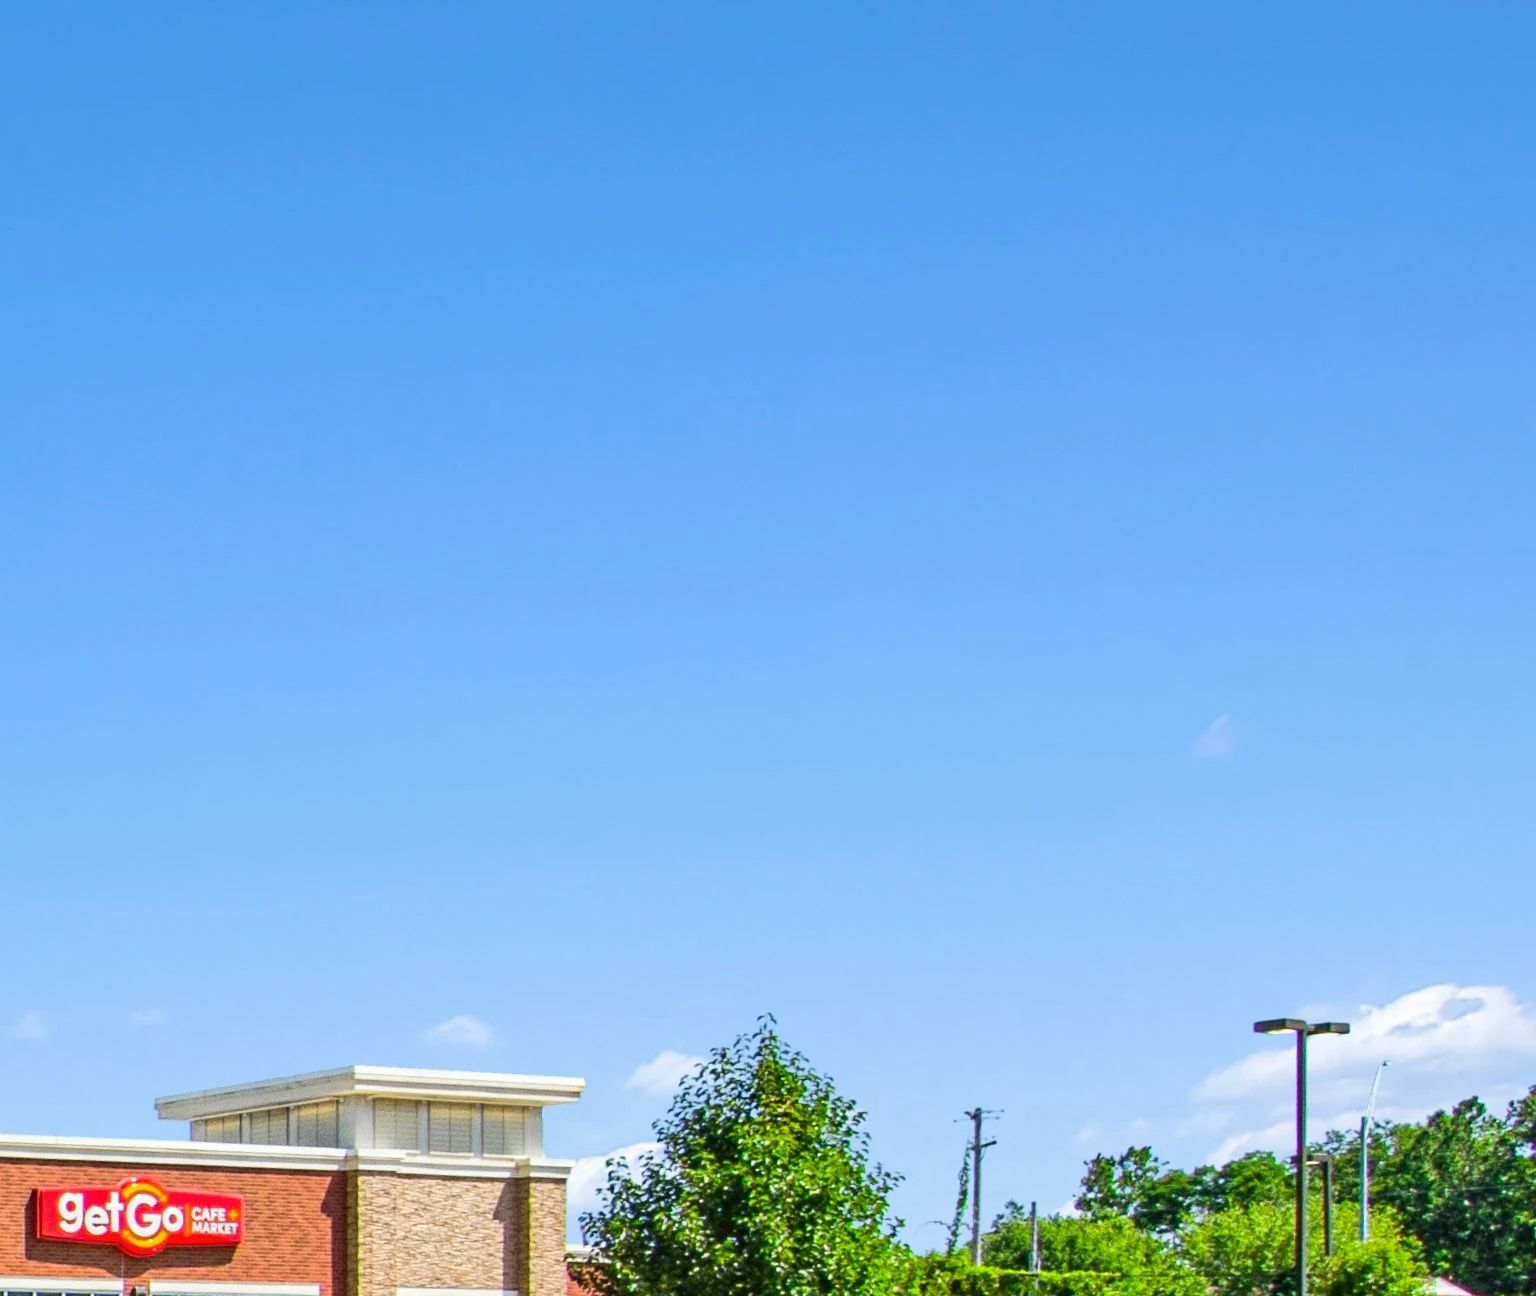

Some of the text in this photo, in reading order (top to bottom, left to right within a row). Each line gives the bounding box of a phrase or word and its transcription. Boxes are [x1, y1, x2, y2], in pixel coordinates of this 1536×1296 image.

[57, 1191, 184, 1238] getGo
[191, 1207, 227, 1222] CAFE
[191, 1221, 239, 1235] MARKET
